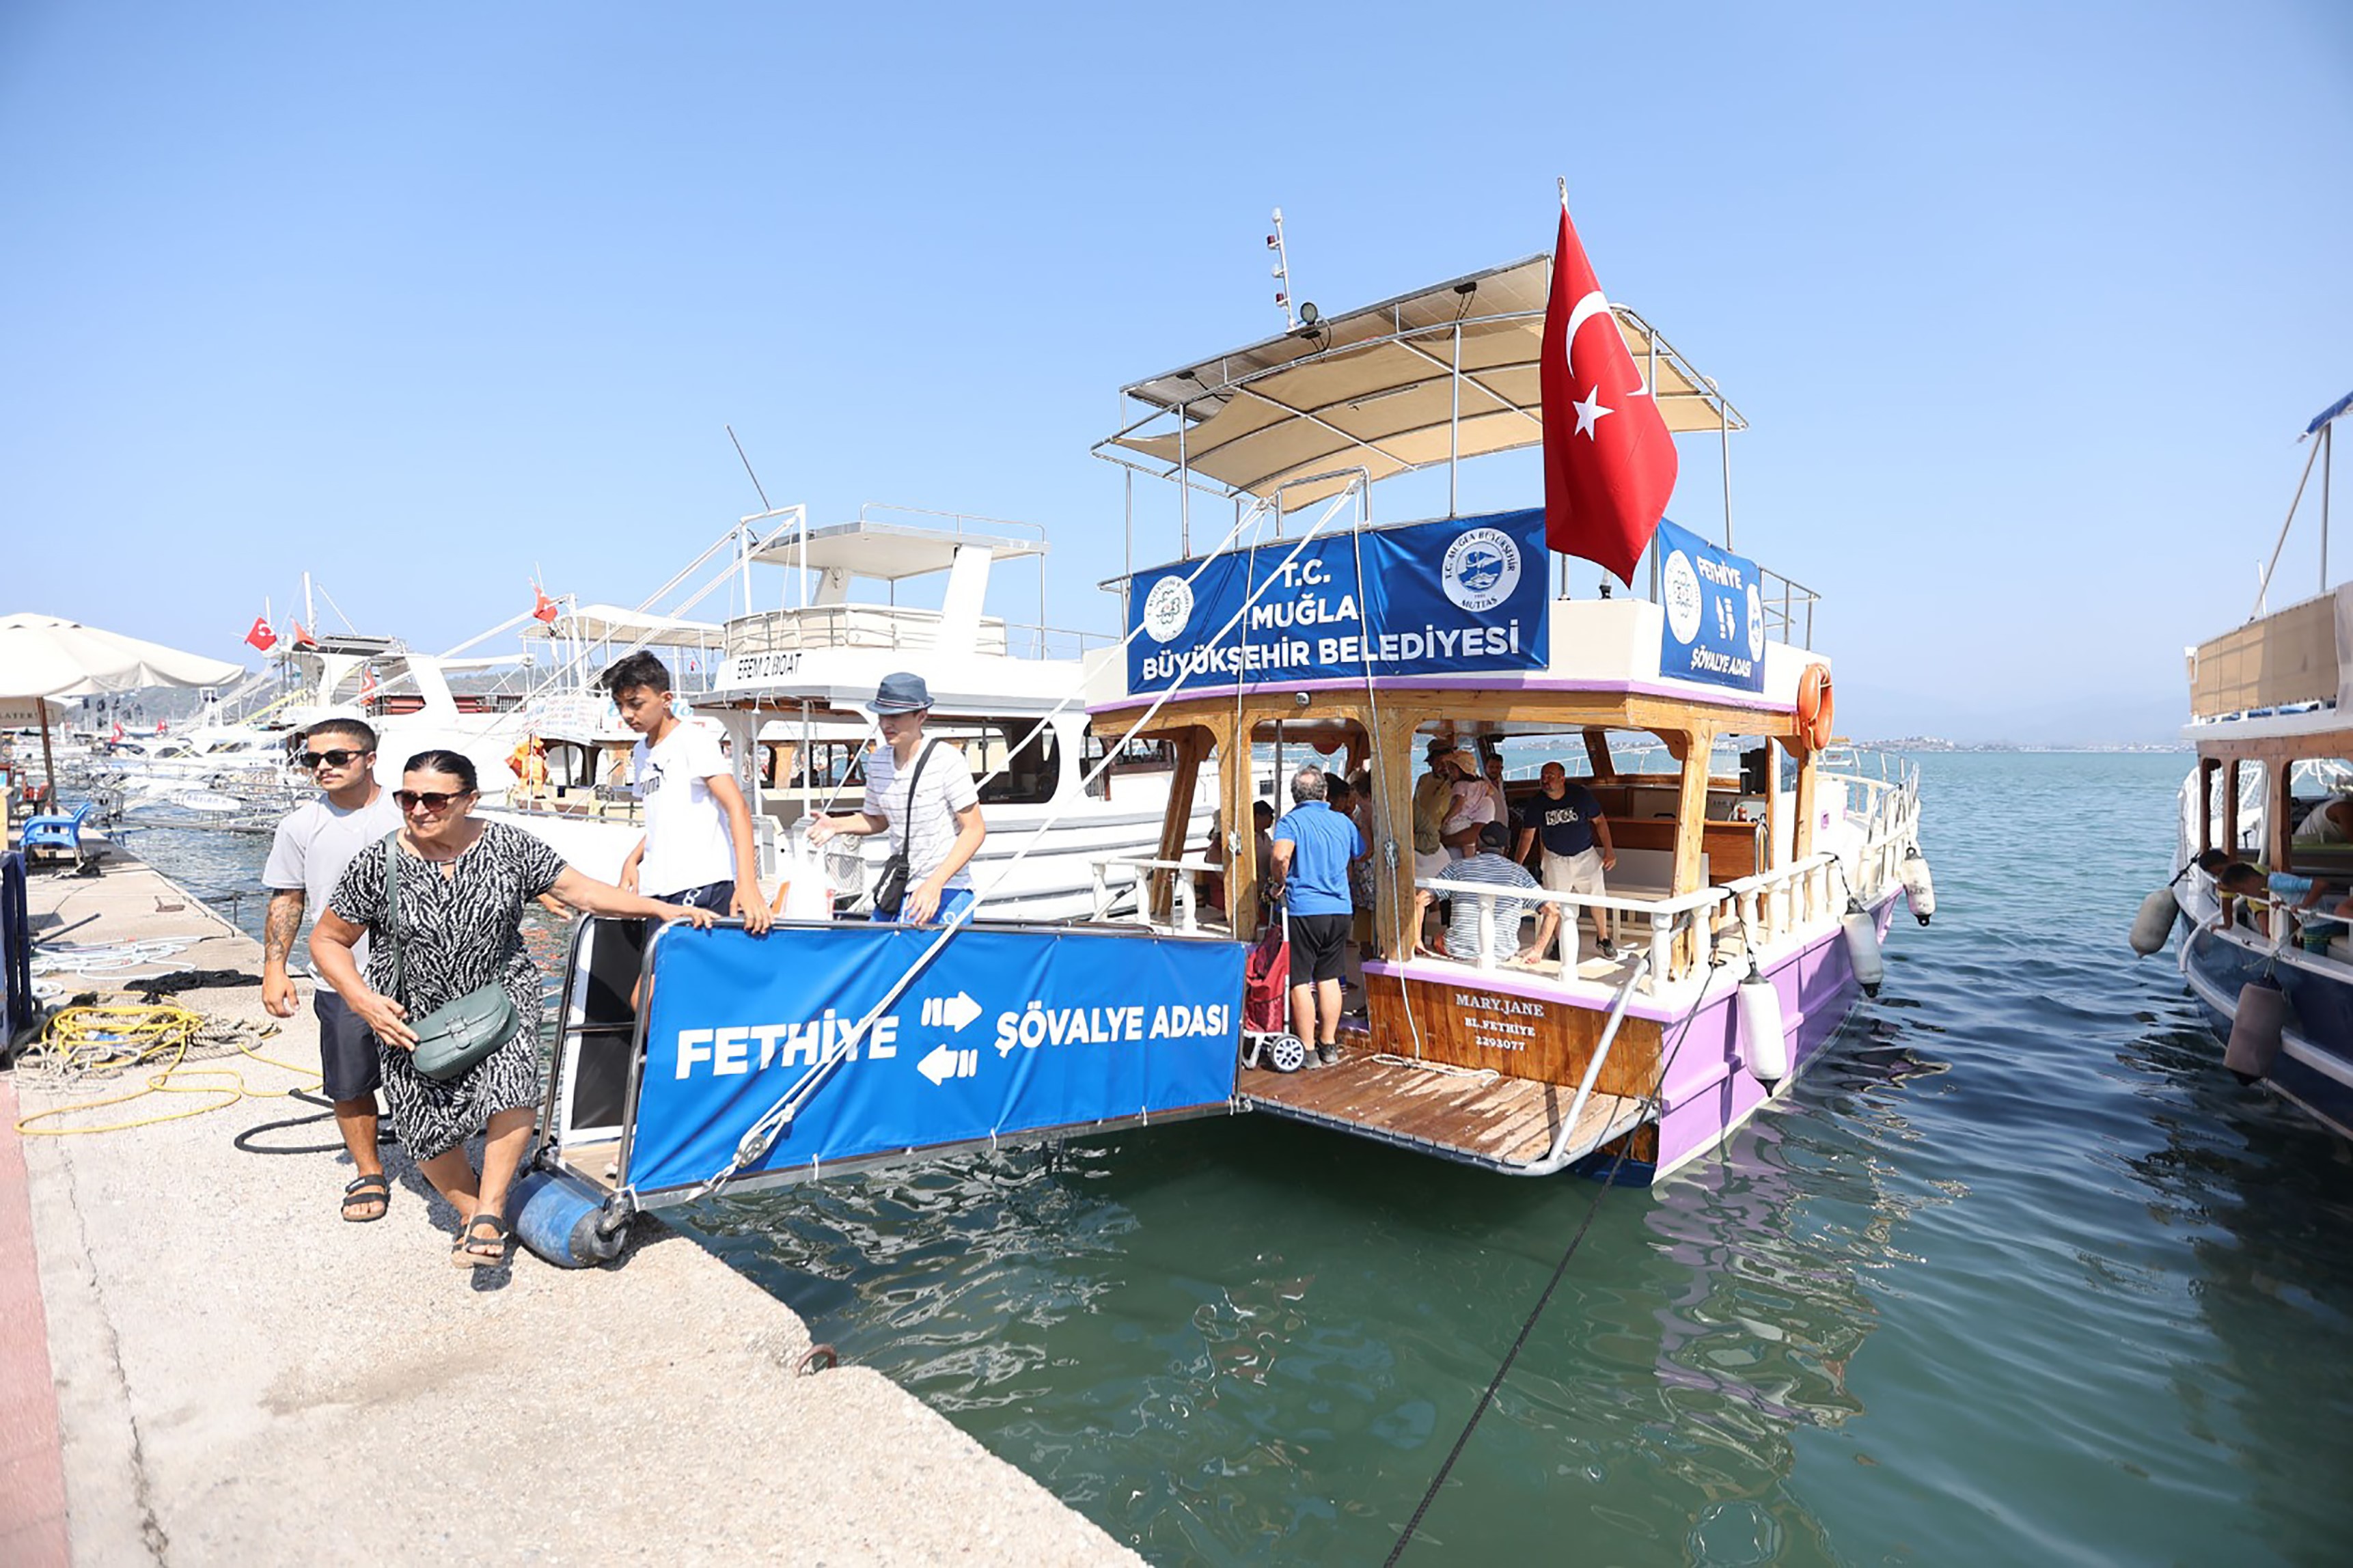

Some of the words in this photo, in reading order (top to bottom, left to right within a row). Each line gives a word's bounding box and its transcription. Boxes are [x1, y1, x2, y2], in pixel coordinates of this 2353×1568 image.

[1280, 558, 1331, 588] T.C.
[1252, 592, 1360, 631] MUĞLA
[1142, 636, 1310, 680] BÜYÜKŞEHİR
[1318, 619, 1519, 665] BELEDİYESİ
[1690, 644, 1731, 674] ŞÖVALYE
[675, 1013, 900, 1079] FETHİYE
[994, 1000, 1144, 1058] ŞÖVALYE
[1148, 1004, 1229, 1040] ADASI
